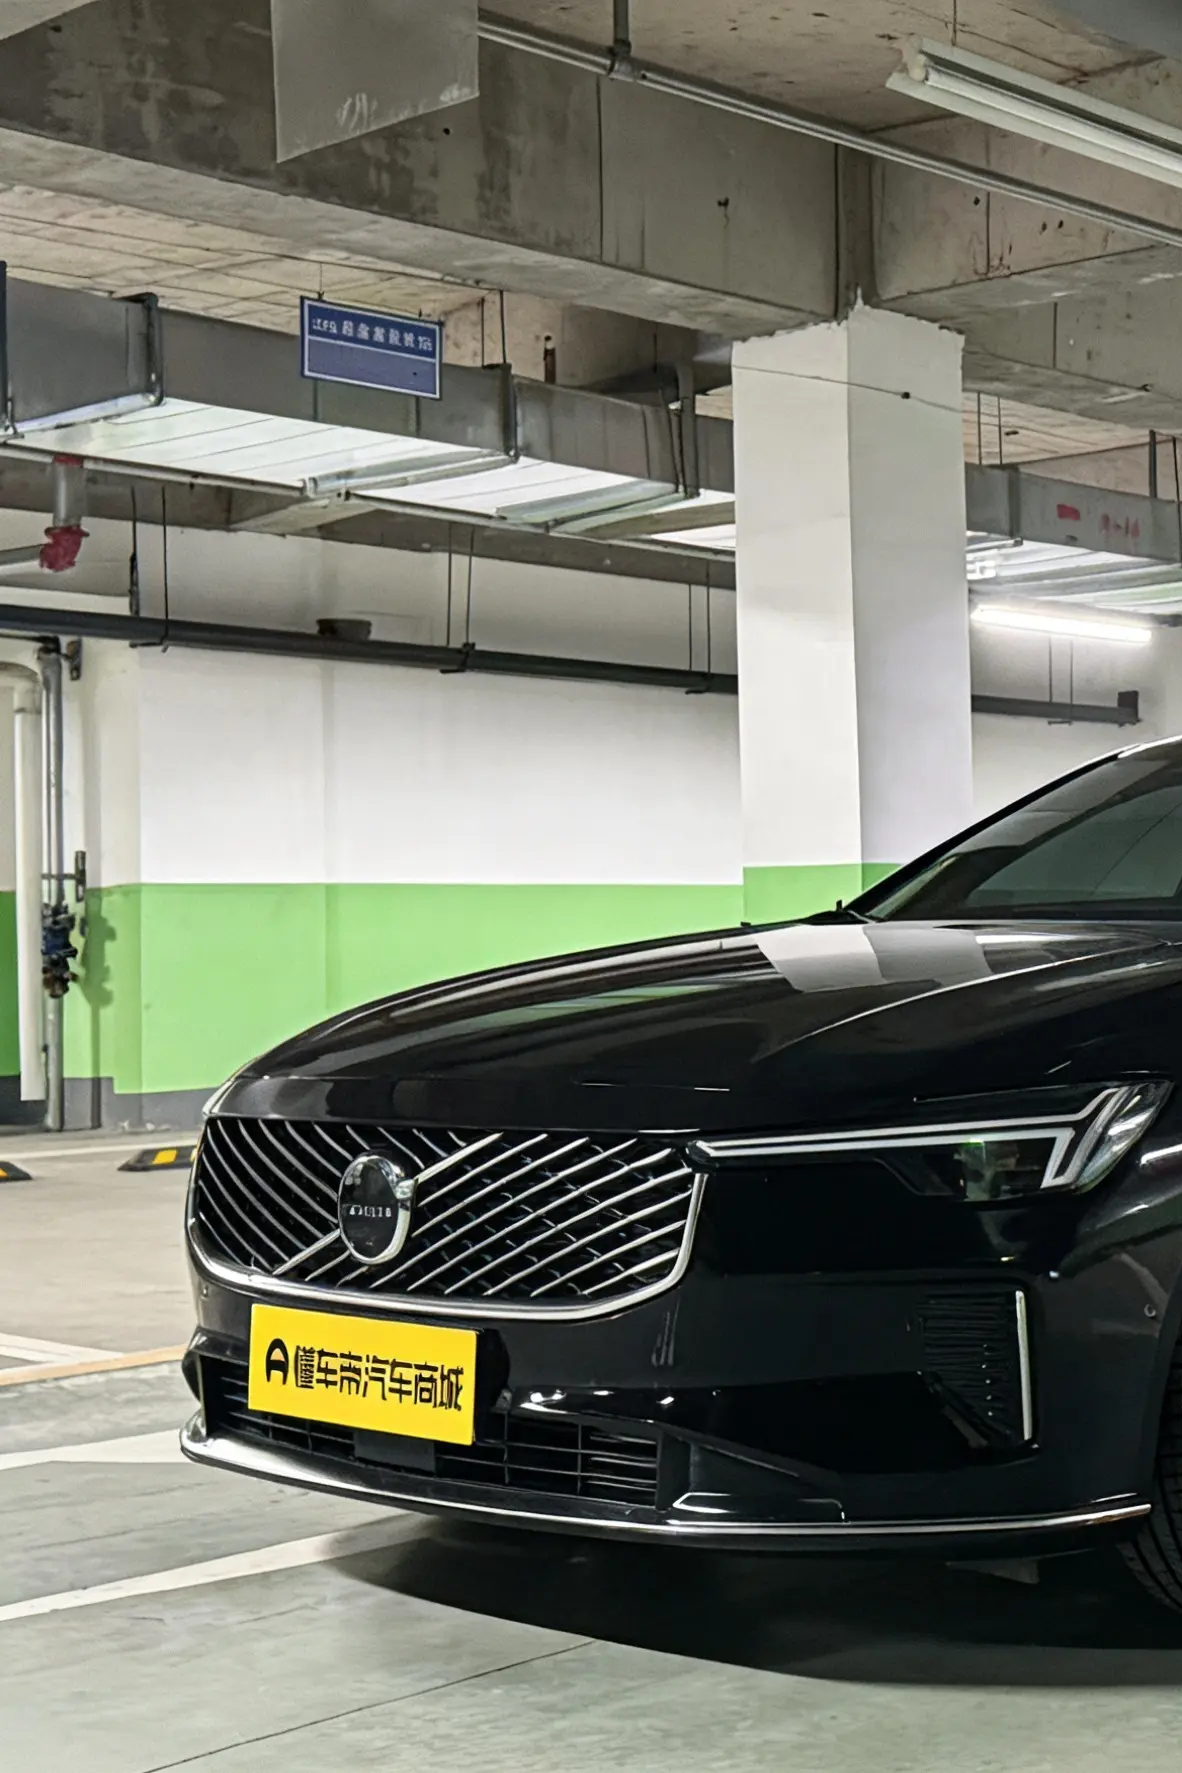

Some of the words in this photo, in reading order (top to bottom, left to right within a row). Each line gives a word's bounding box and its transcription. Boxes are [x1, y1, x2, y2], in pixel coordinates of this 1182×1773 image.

[294, 1345, 464, 1412] 懂车帝汽车商城
